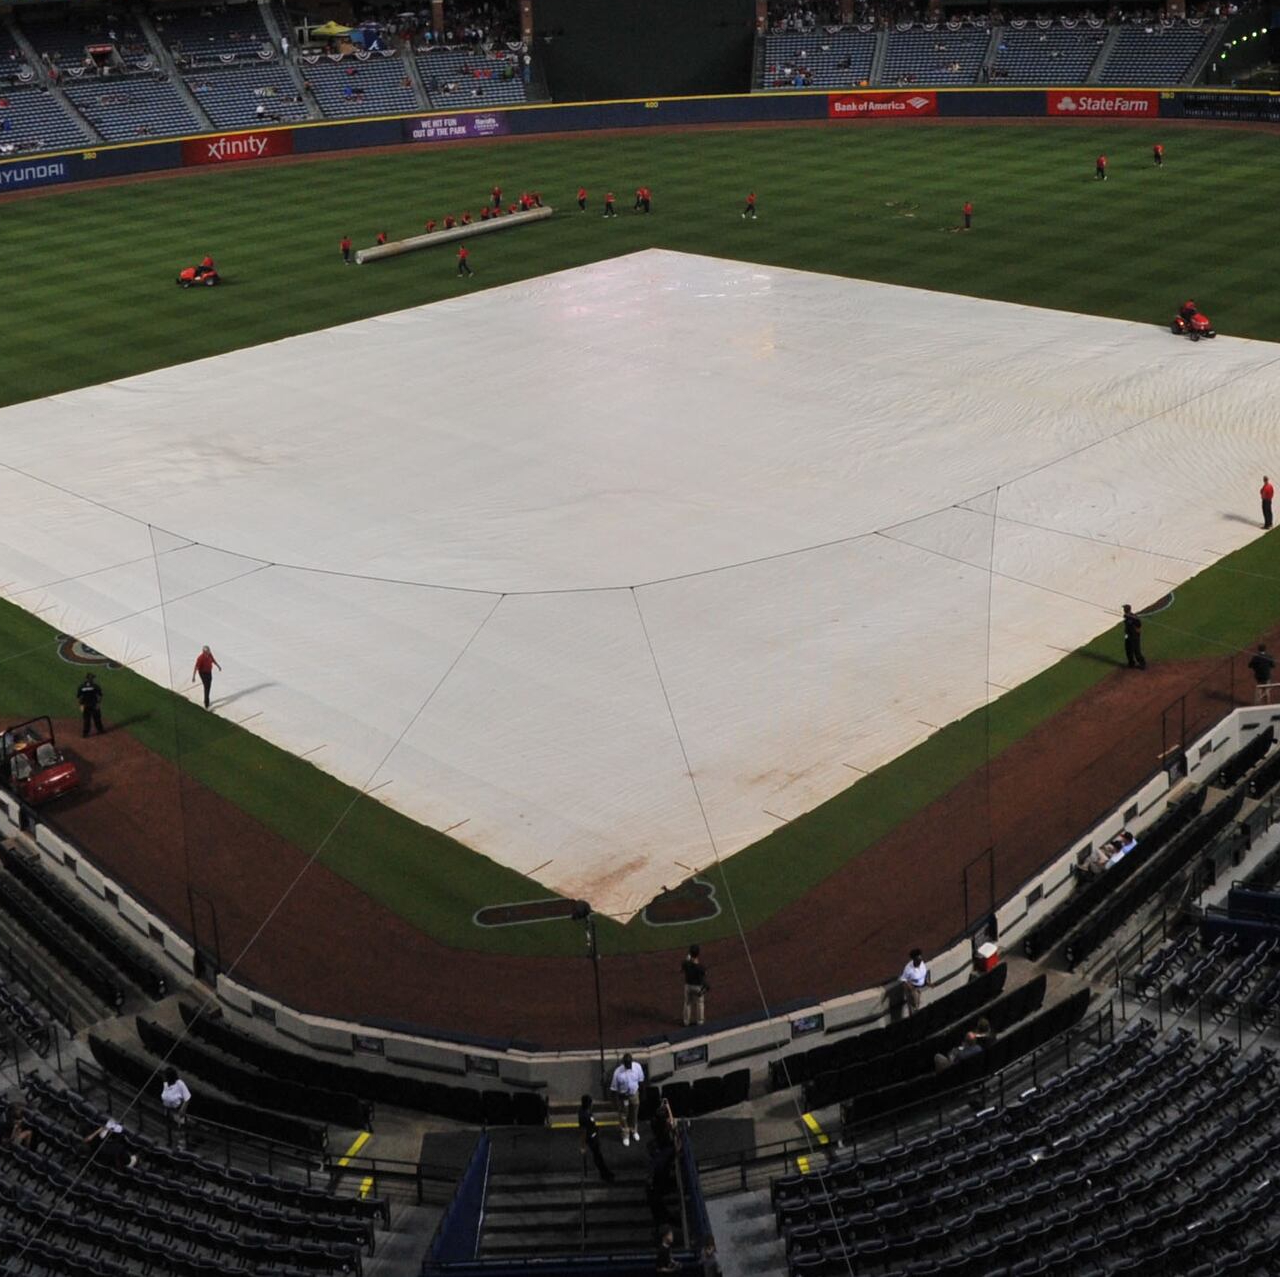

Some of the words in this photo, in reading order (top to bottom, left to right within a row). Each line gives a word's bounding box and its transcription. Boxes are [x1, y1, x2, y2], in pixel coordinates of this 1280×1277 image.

[834, 101, 857, 111] Bank
[858, 101, 868, 111] of
[868, 100, 906, 111] America
[444, 118, 457, 127] FUN
[413, 130, 426, 138] OUT
[436, 127, 448, 136] THE
[449, 126, 466, 135] PARK
[207, 135, 268, 160] xfinity
